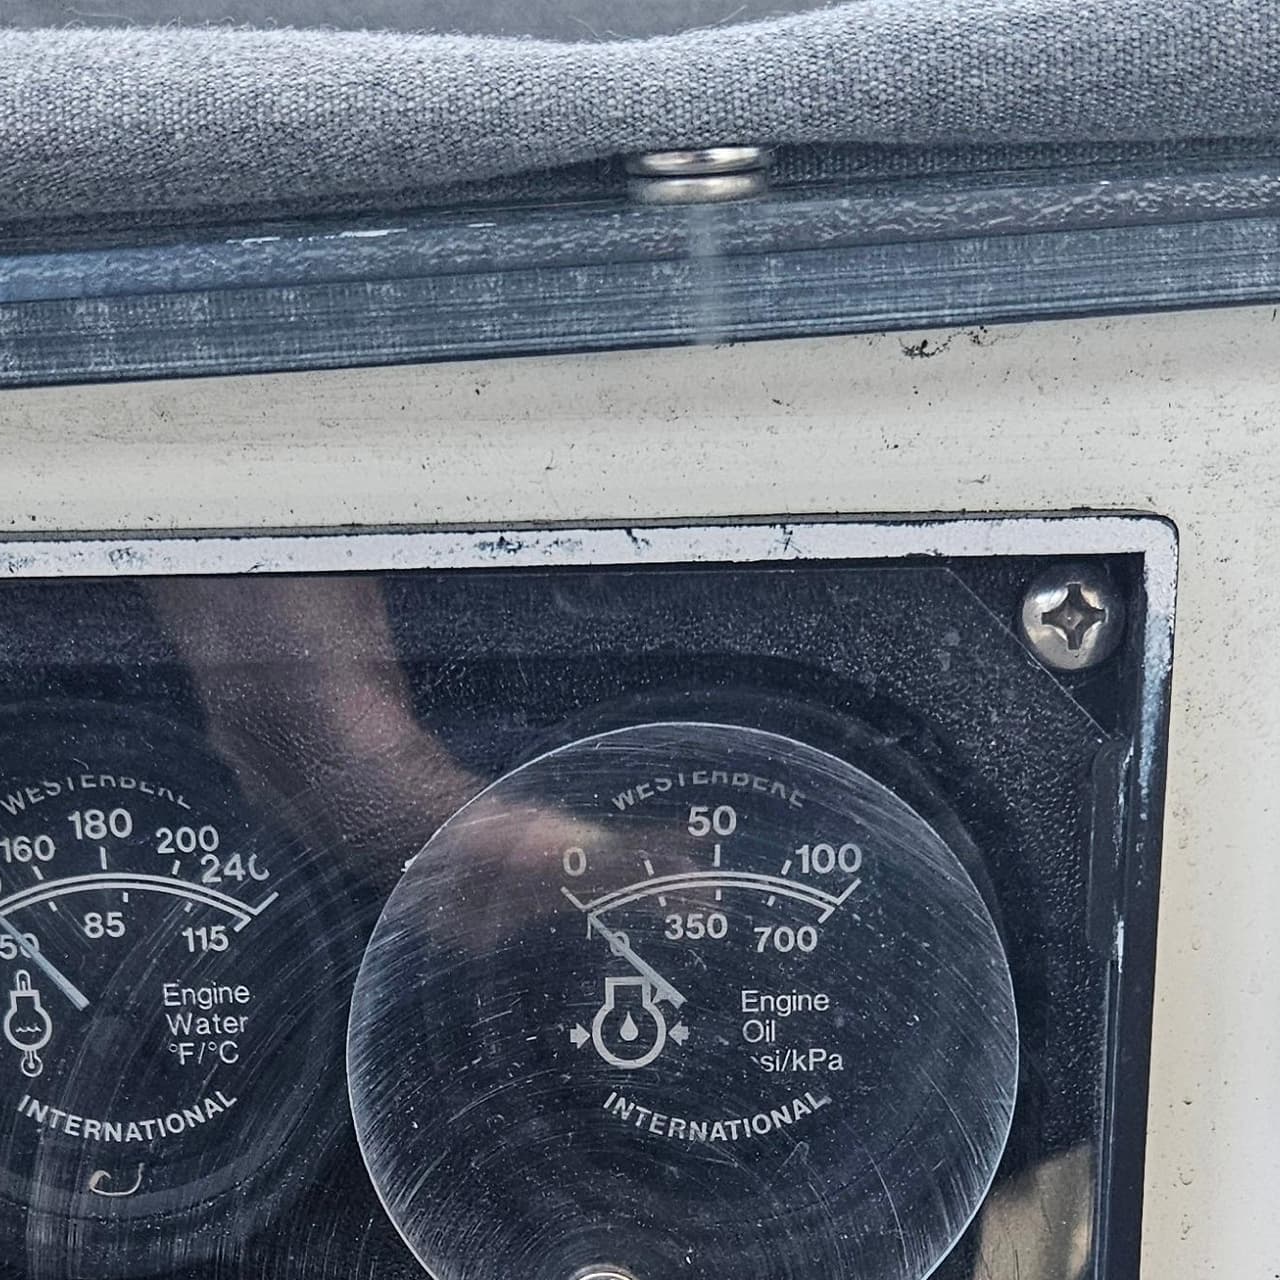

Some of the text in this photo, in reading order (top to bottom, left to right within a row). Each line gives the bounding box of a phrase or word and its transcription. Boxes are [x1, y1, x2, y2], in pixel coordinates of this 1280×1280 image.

[67, 808, 133, 840] 180
[687, 805, 737, 837] 50
[155, 825, 219, 854] 200
[563, 847, 587, 876] 0
[795, 843, 862, 874] 100
[84, 912, 126, 939] 85
[182, 925, 229, 953] 115
[664, 913, 728, 940] 350
[753, 925, 818, 954] 700
[163, 982, 250, 1008] Engine
[741, 989, 829, 1017] Engine
[168, 1013, 248, 1035] Water
[743, 1019, 776, 1042] Oil
[752, 1049, 844, 1073] si/kPa
[17, 1091, 238, 1143] INTERNATIONAL
[602, 1091, 831, 1143] INTERNATIONAL
